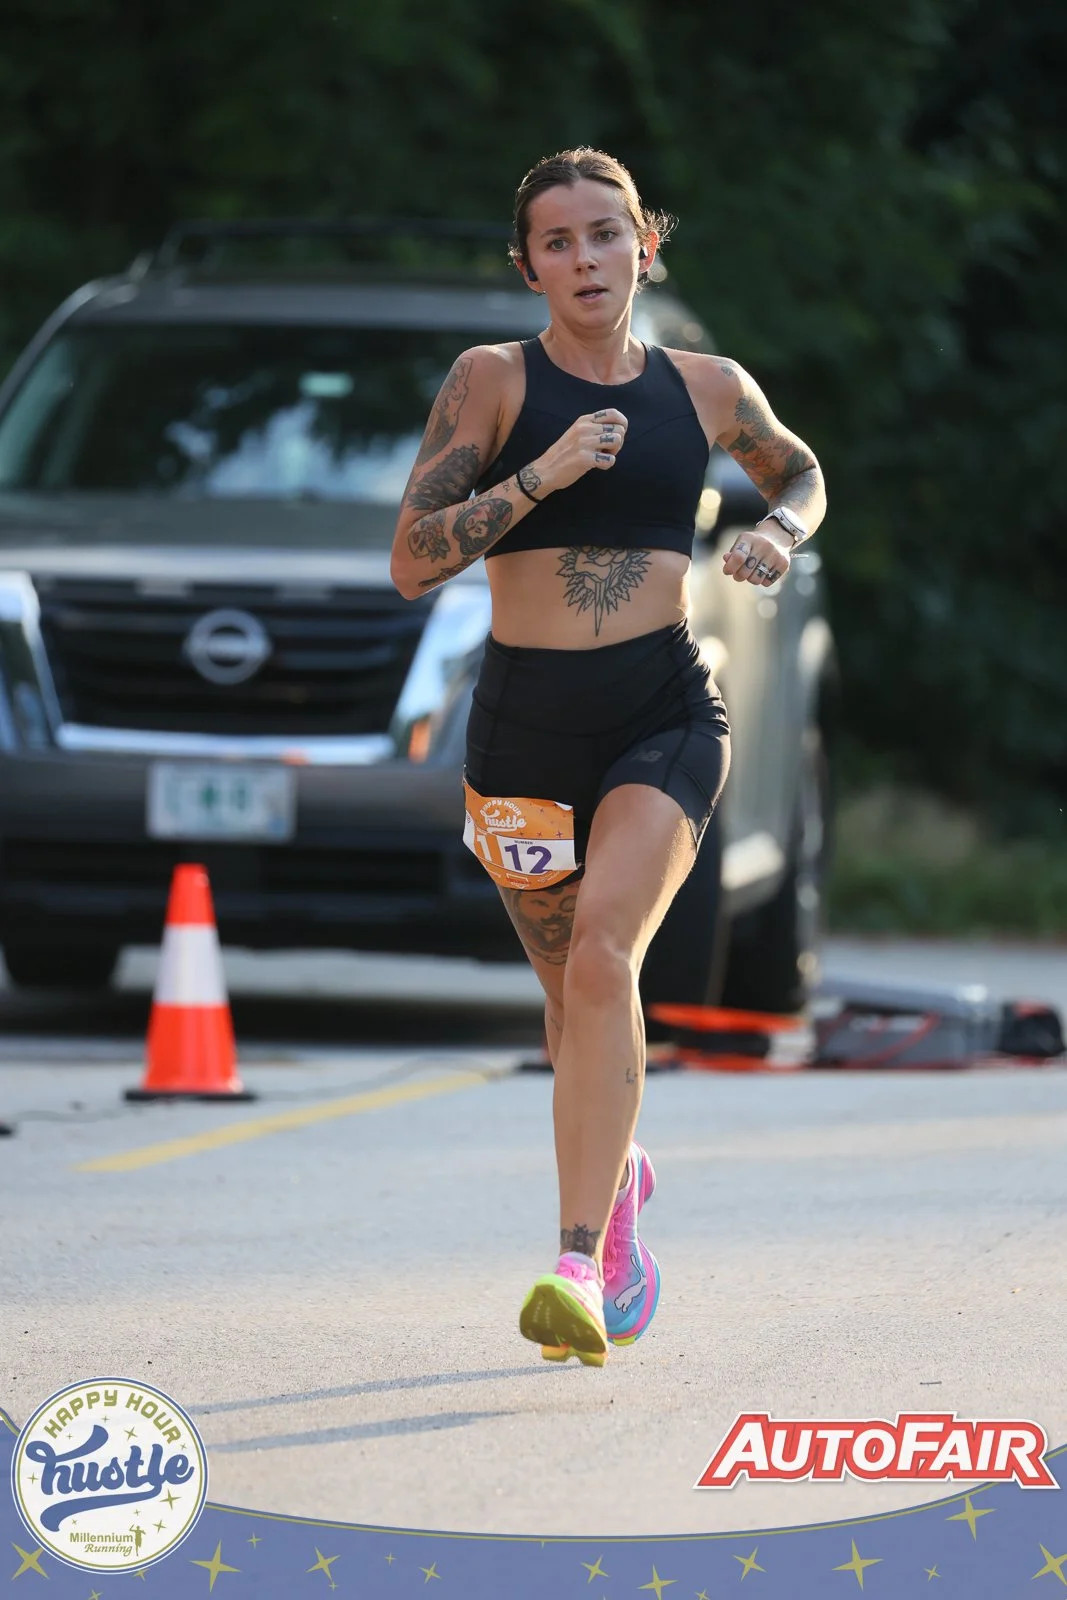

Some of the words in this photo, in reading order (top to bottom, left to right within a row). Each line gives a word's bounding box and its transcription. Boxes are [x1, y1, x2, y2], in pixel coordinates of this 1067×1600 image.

[503, 800, 522, 816] HOUR
[480, 809, 527, 834] hustle
[504, 844, 552, 874] 12
